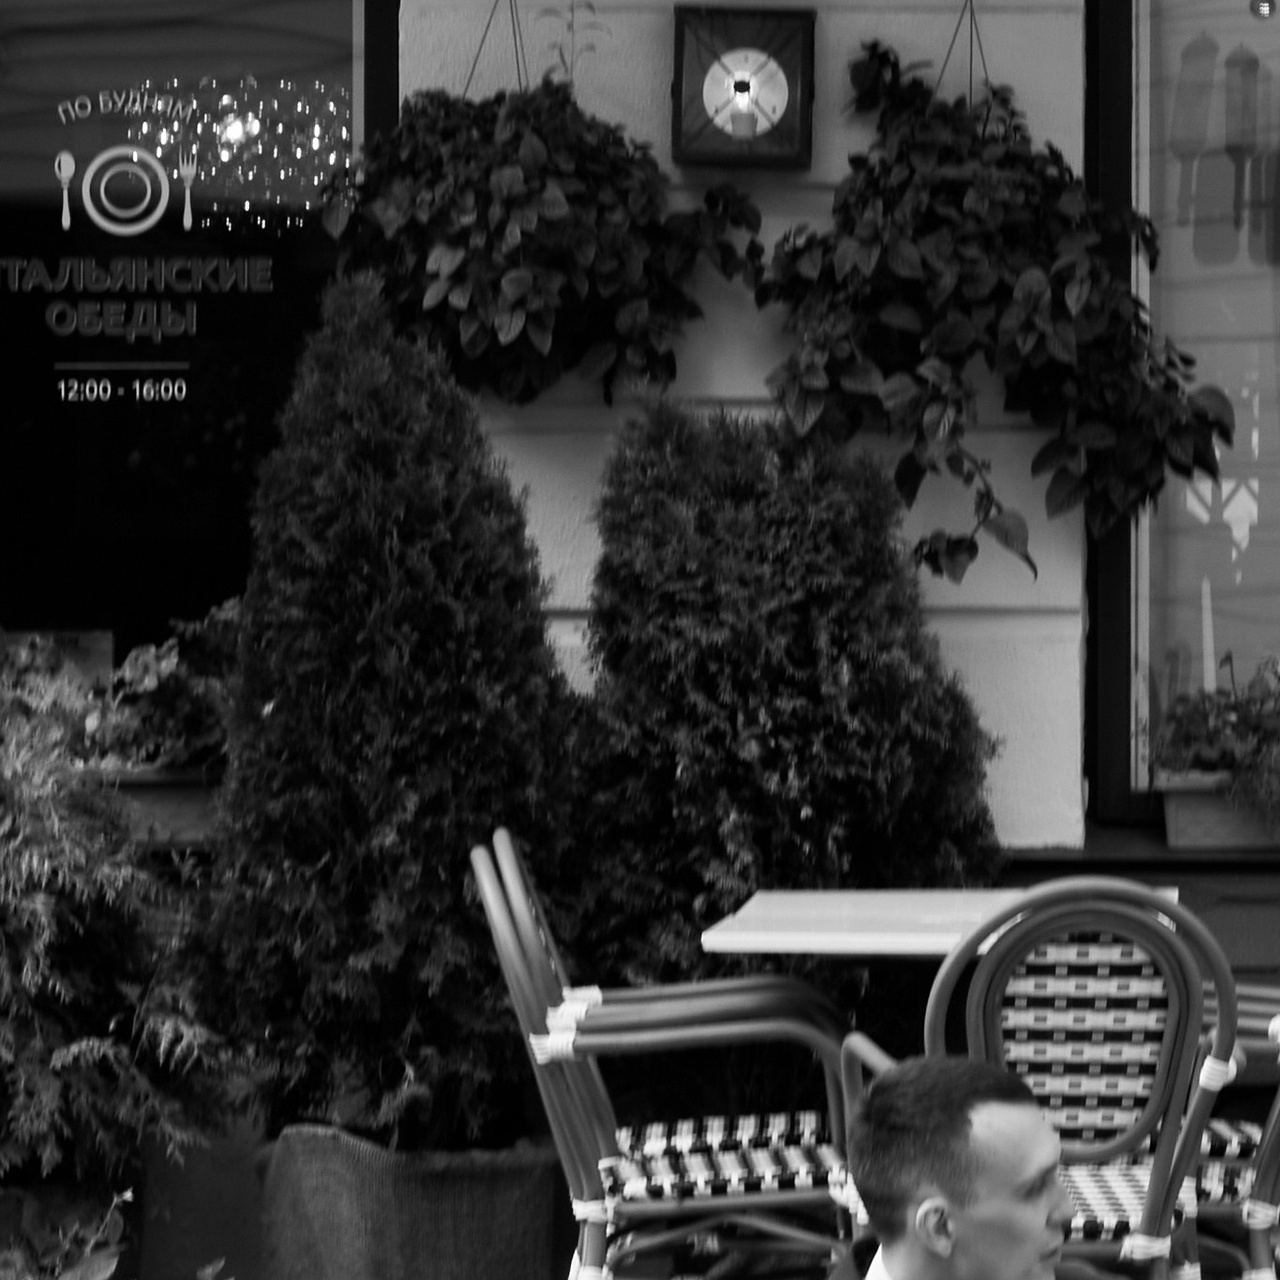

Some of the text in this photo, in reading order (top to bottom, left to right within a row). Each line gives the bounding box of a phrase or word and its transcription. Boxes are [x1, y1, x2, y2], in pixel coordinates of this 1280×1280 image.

[58, 87, 194, 126] ПО БУДНЯМ
[0, 254, 275, 293] ТАЛЬЯНСКИЕ
[44, 298, 198, 345] ОБЕДЫ
[57, 377, 112, 403] 12:00
[131, 377, 188, 403] 16:00
